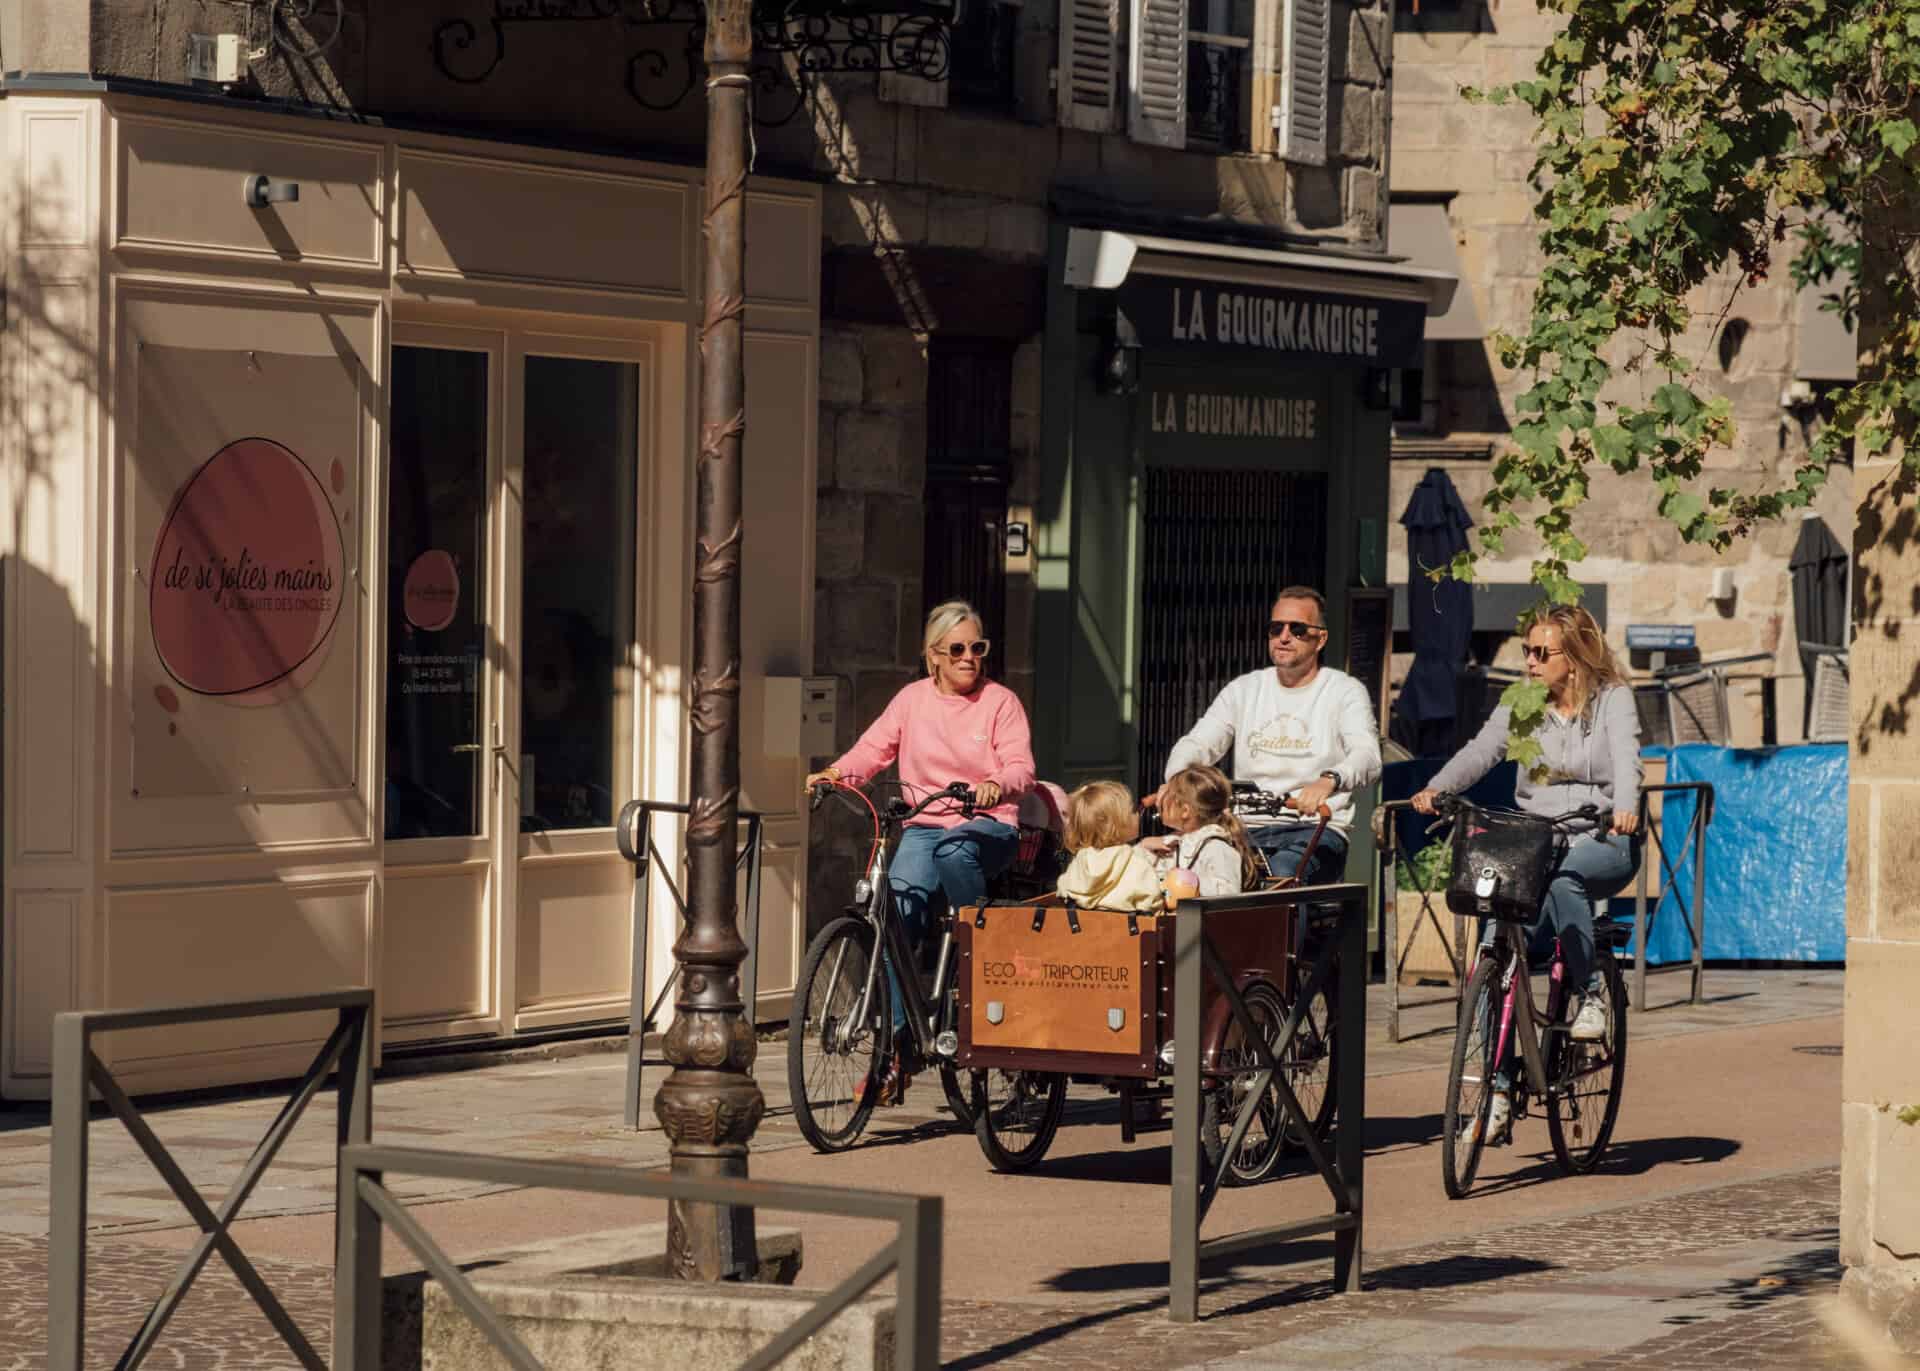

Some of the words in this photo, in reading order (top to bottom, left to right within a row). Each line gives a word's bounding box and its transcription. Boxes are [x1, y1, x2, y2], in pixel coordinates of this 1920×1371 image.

[1172, 287, 1207, 341] LA
[1217, 292, 1379, 356] GOURMANDISE
[1151, 391, 1177, 433] LA
[1186, 394, 1316, 439] GOURMANDISE
[164, 547, 188, 590] de
[195, 556, 213, 591] si
[212, 547, 267, 603] jolies
[273, 560, 332, 591] mains
[983, 961, 1017, 978] ECO
[1042, 964, 1129, 982] TRIPORTEUR
